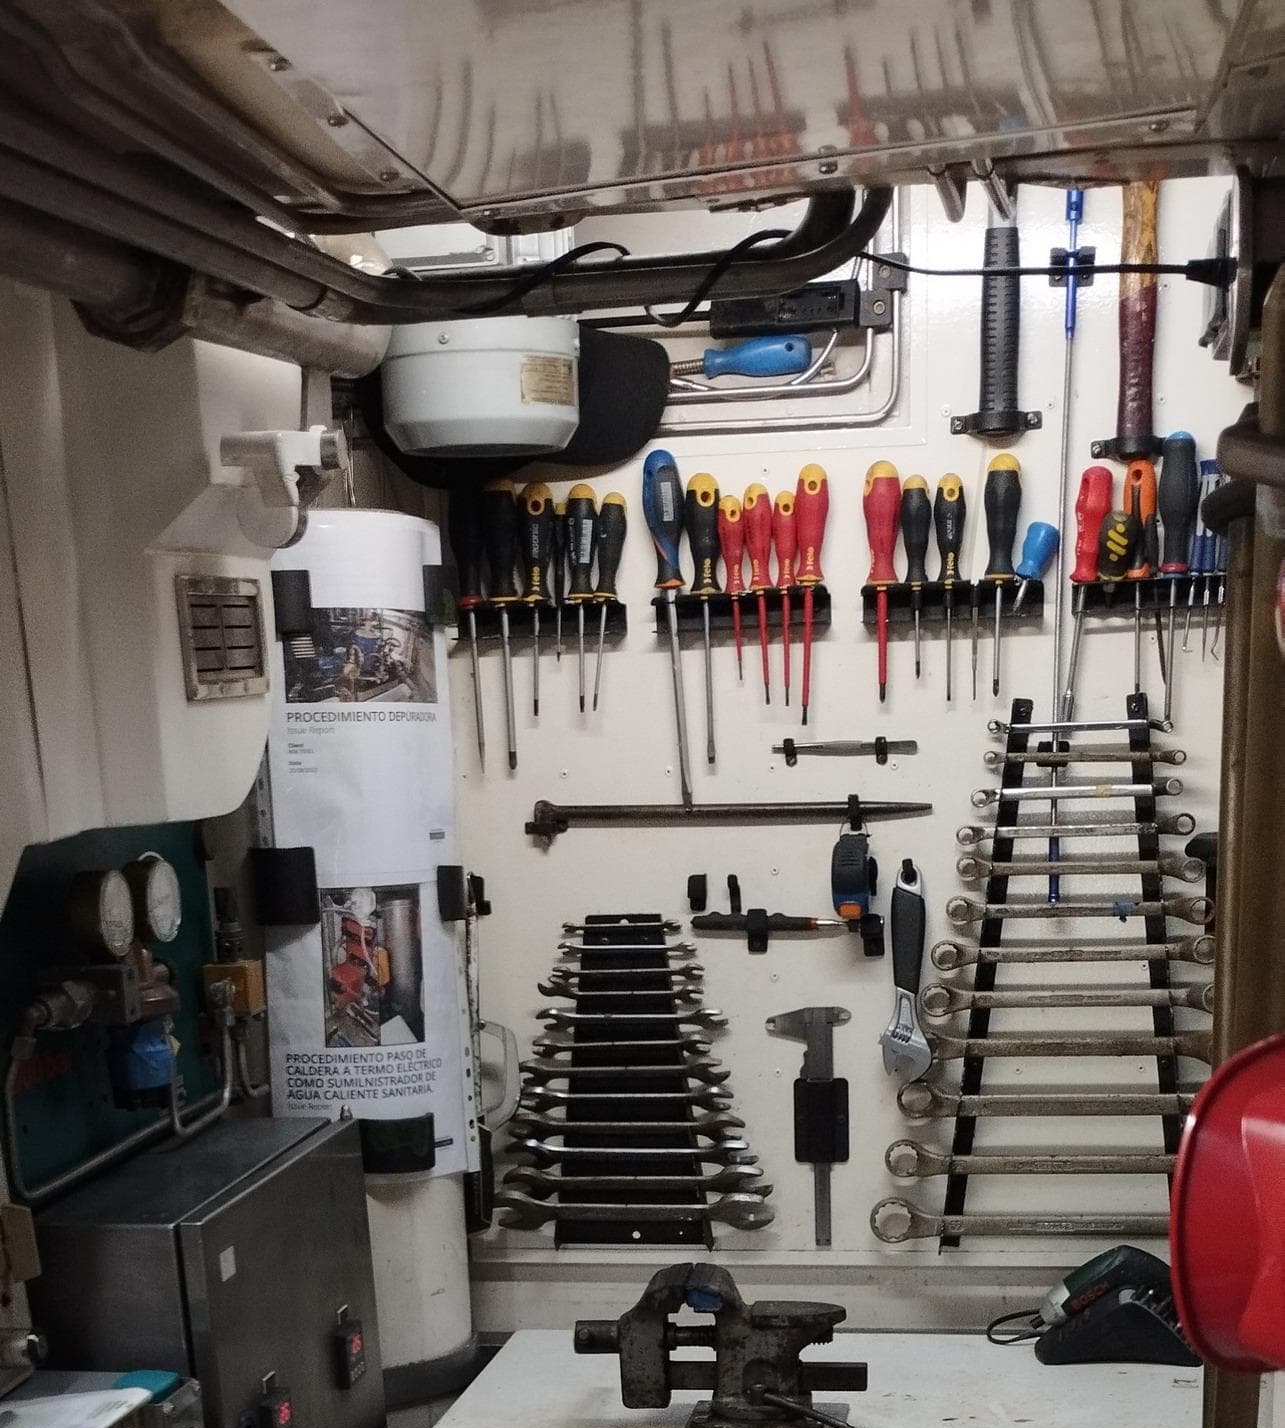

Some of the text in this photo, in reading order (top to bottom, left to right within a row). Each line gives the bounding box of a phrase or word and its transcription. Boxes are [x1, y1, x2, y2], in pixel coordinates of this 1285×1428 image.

[286, 711, 437, 722] PROCEDIMIENTO DEPURADORA
[286, 1048, 427, 1064] PROCEDIMIENTO PASO DE
[286, 1065, 340, 1076] CALDERA
[343, 1065, 352, 1076] A
[354, 1064, 395, 1075] TERMO
[287, 1077, 325, 1088] COMO
[425, 1071, 437, 1082] DE
[287, 1089, 322, 1101] AGUA
[324, 1088, 380, 1100] CALIENTE
